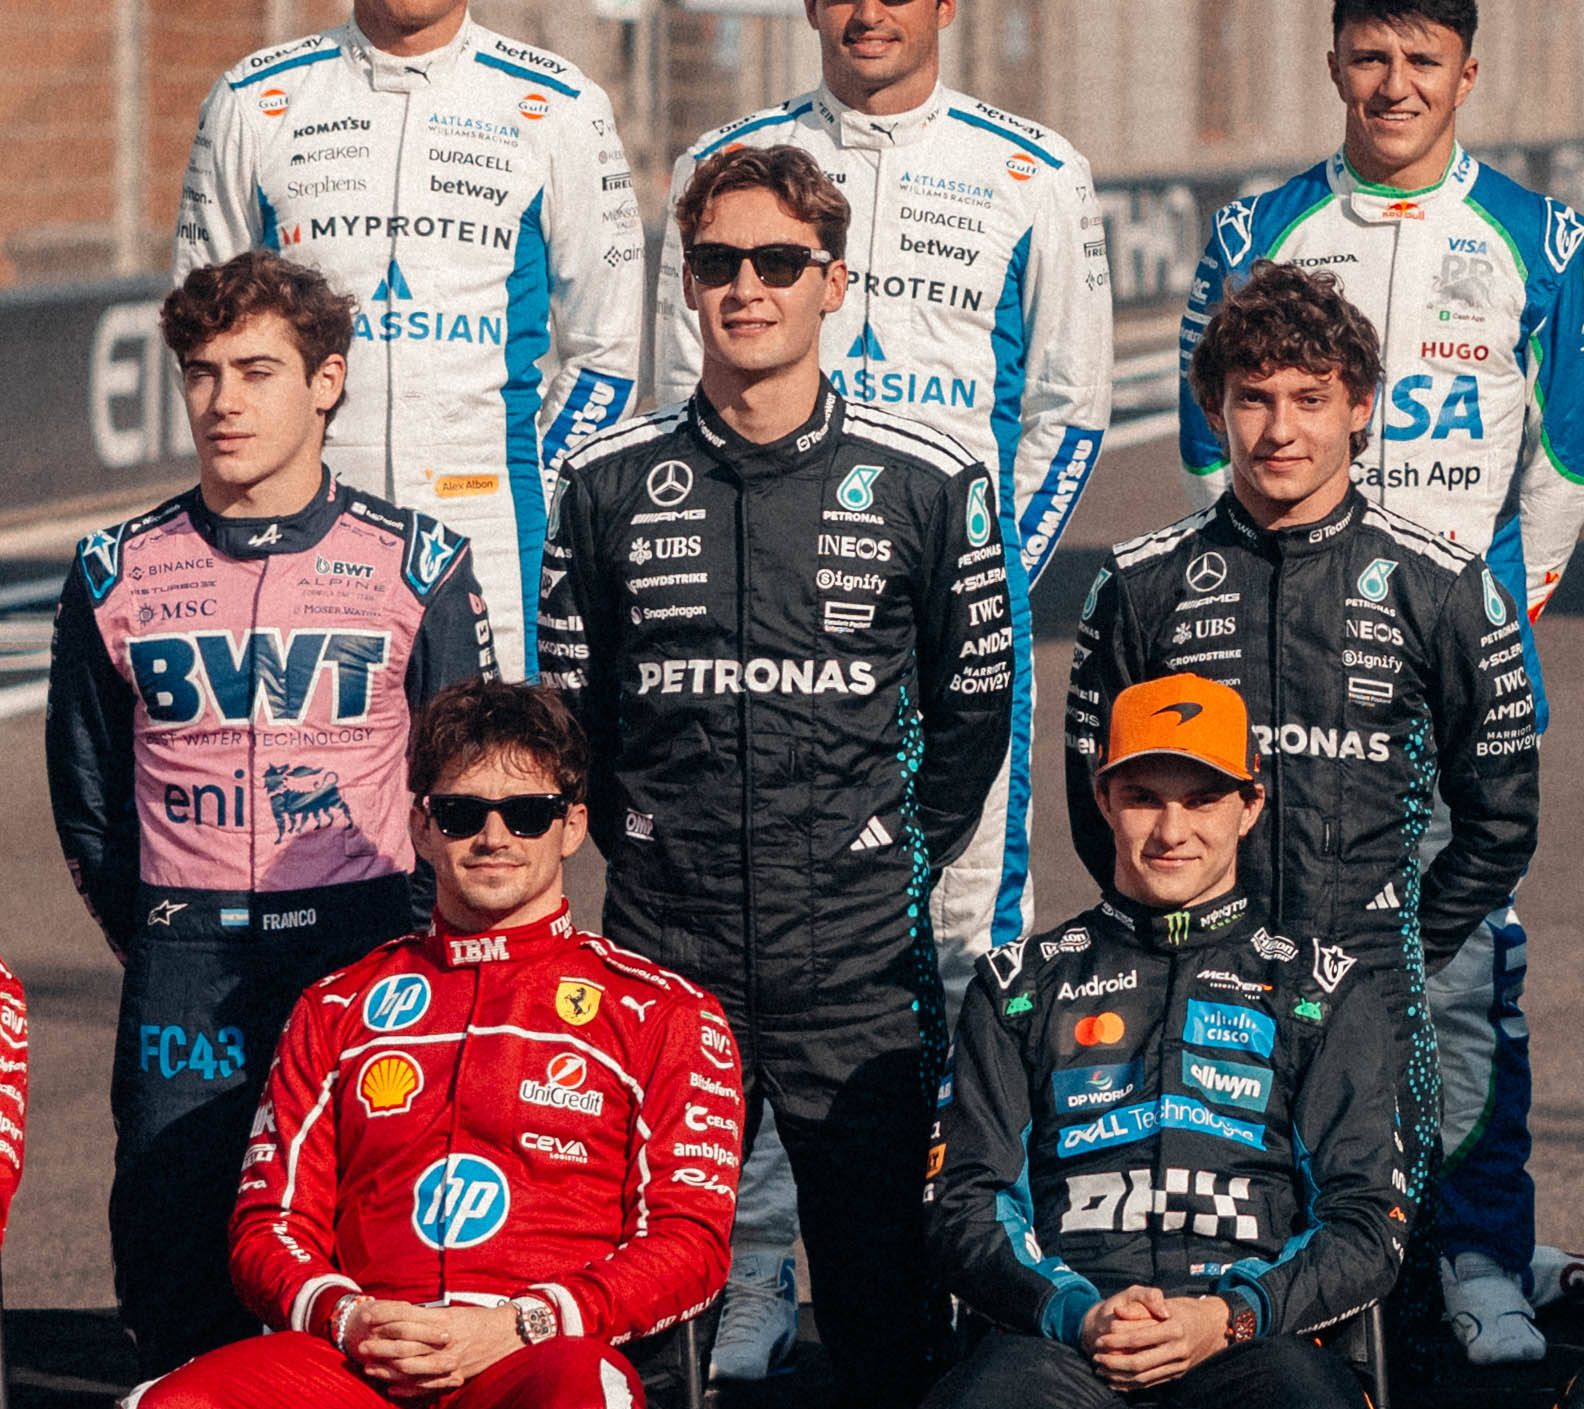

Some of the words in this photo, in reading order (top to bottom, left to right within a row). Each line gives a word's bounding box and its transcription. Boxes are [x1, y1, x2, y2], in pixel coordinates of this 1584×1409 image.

[495, 40, 568, 75] betway
[442, 115, 520, 140] ATLASSIAN
[975, 102, 1046, 140] betway
[428, 148, 513, 173] DURACELL
[288, 175, 367, 199] Stephens
[430, 176, 508, 206] betway
[913, 175, 994, 198] ATLASSIAN
[900, 206, 986, 234] DURACELL
[311, 216, 513, 251] MYPROTEIN
[1449, 238, 1487, 253] VISA
[900, 235, 979, 266] betway
[355, 312, 501, 345] ASSIAN
[1421, 342, 1489, 361] HUGO
[443, 482, 464, 491] Alex
[466, 479, 493, 490] Albon
[1350, 462, 1417, 488] Cash
[1428, 462, 1480, 489] App
[823, 511, 884, 525] PETRONAS
[655, 536, 701, 557] UBS
[818, 536, 890, 562] INEOS
[958, 543, 1001, 567] PETRONAS
[148, 558, 214, 574] BINANCE
[333, 562, 374, 579] BWT
[297, 577, 385, 592] ALPINE
[632, 573, 707, 590] CROWDSTRIKE
[161, 599, 217, 622] MSC
[644, 604, 706, 620] Snapdragon
[969, 595, 1003, 626] IWC
[1345, 598, 1396, 617] PETRONAS
[1195, 618, 1236, 638] UBS
[1170, 649, 1241, 667] CROWDSTRIKE
[127, 628, 391, 726] BWT
[639, 658, 875, 695] PETRONAS
[1495, 667, 1528, 697] IWC
[166, 769, 244, 827] eni
[263, 909, 316, 930] FRANCO
[451, 937, 509, 962] IBM
[1058, 971, 1137, 1000] Android
[374, 974, 420, 1029] hp
[1207, 1028, 1249, 1043] CISCO
[1191, 1065, 1260, 1097] allwyn
[522, 1081, 602, 1113] UniCredit
[1068, 1093, 1089, 1107] DP
[1090, 1084, 1133, 1105] WORLD
[423, 1155, 496, 1247] hp
